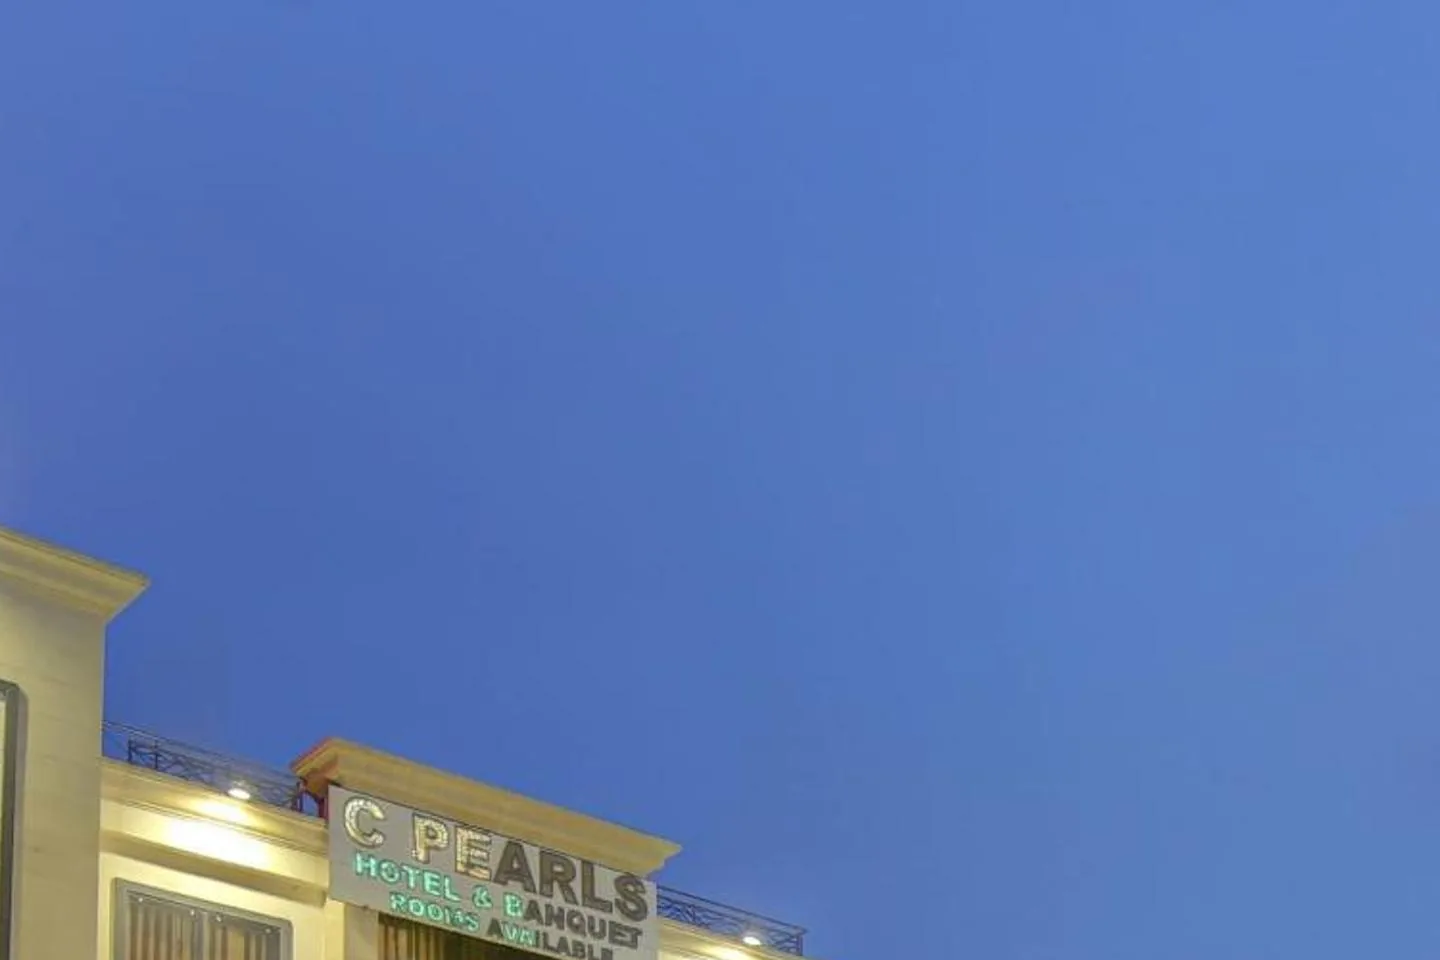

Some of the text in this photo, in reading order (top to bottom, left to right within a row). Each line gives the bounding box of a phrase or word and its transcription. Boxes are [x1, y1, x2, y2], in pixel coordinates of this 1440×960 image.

[343, 796, 649, 922] C PEARLS
[354, 850, 643, 950] HOTEL & BANQUET
[388, 890, 482, 933] ROOMS
